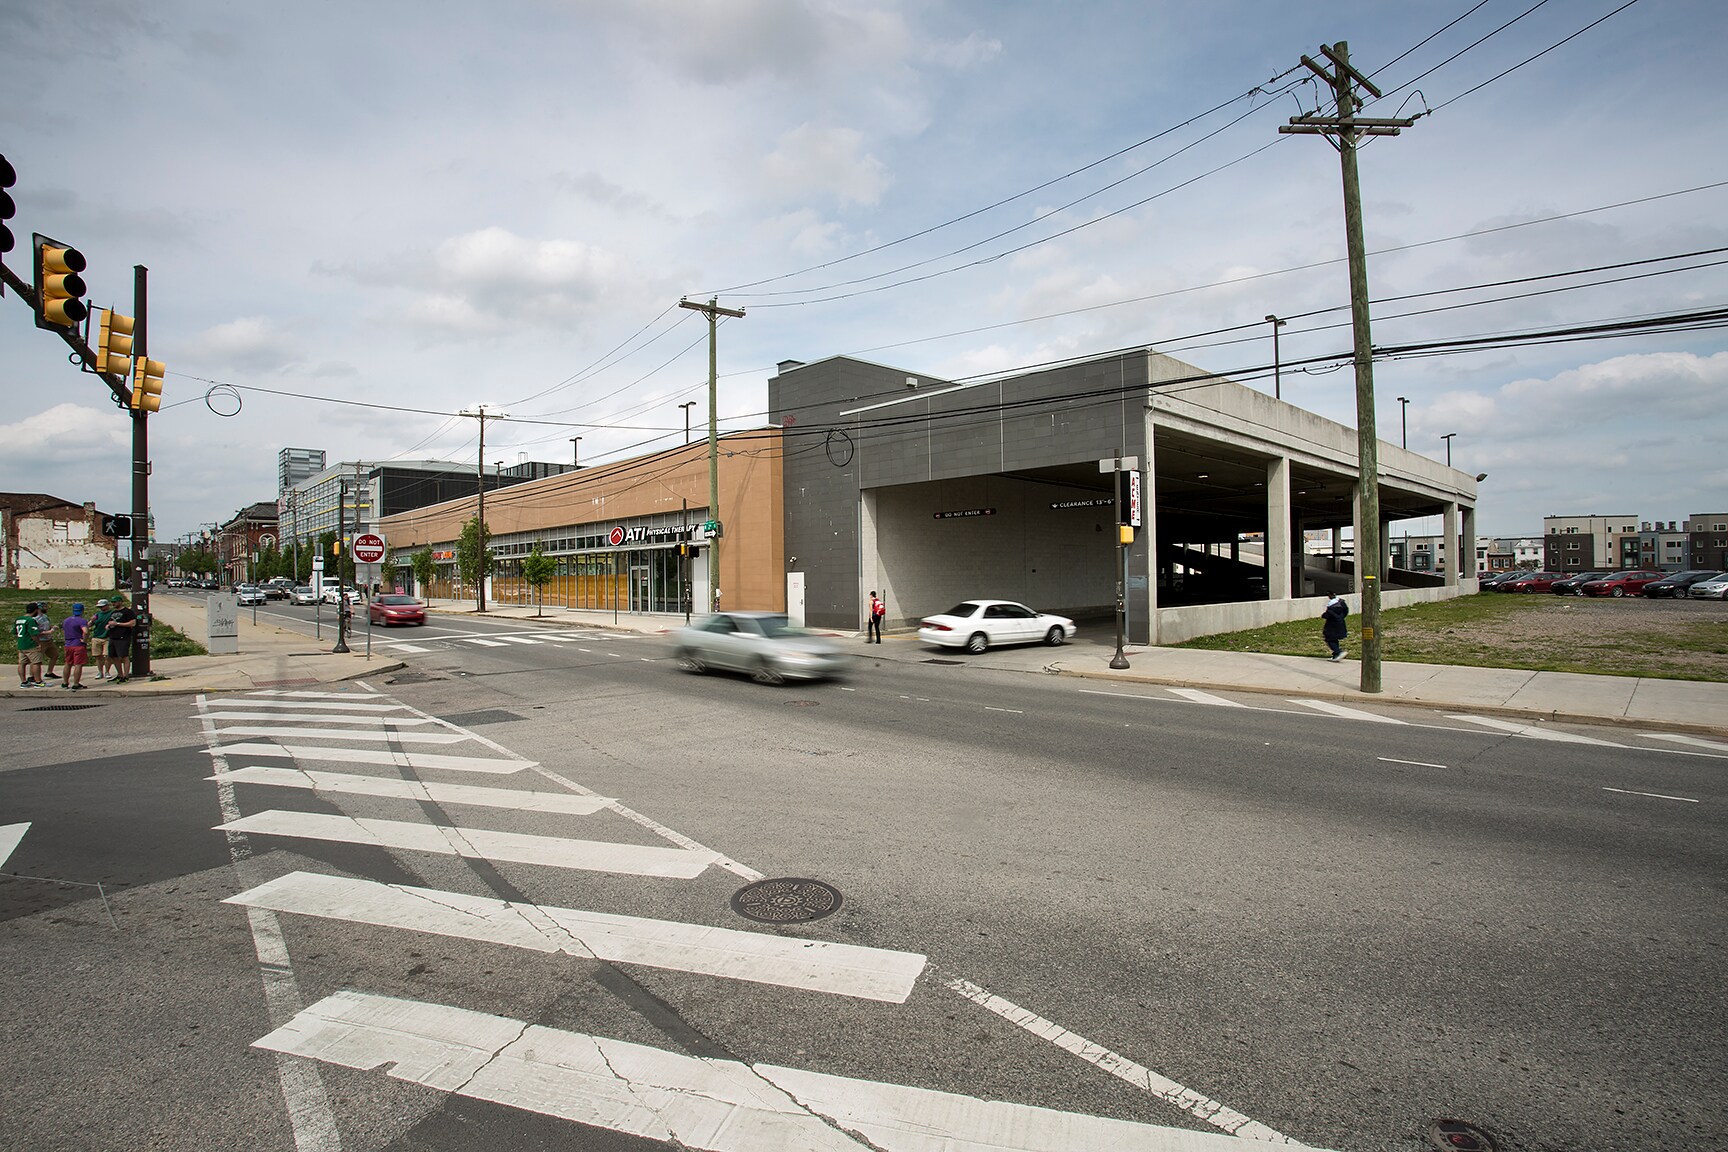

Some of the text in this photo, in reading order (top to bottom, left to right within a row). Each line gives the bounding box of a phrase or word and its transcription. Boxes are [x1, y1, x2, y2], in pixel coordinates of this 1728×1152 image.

[1060, 500, 1093, 508] CLEARANCE
[625, 527, 646, 542] ATI
[646, 528, 670, 536] PHYSICAL
